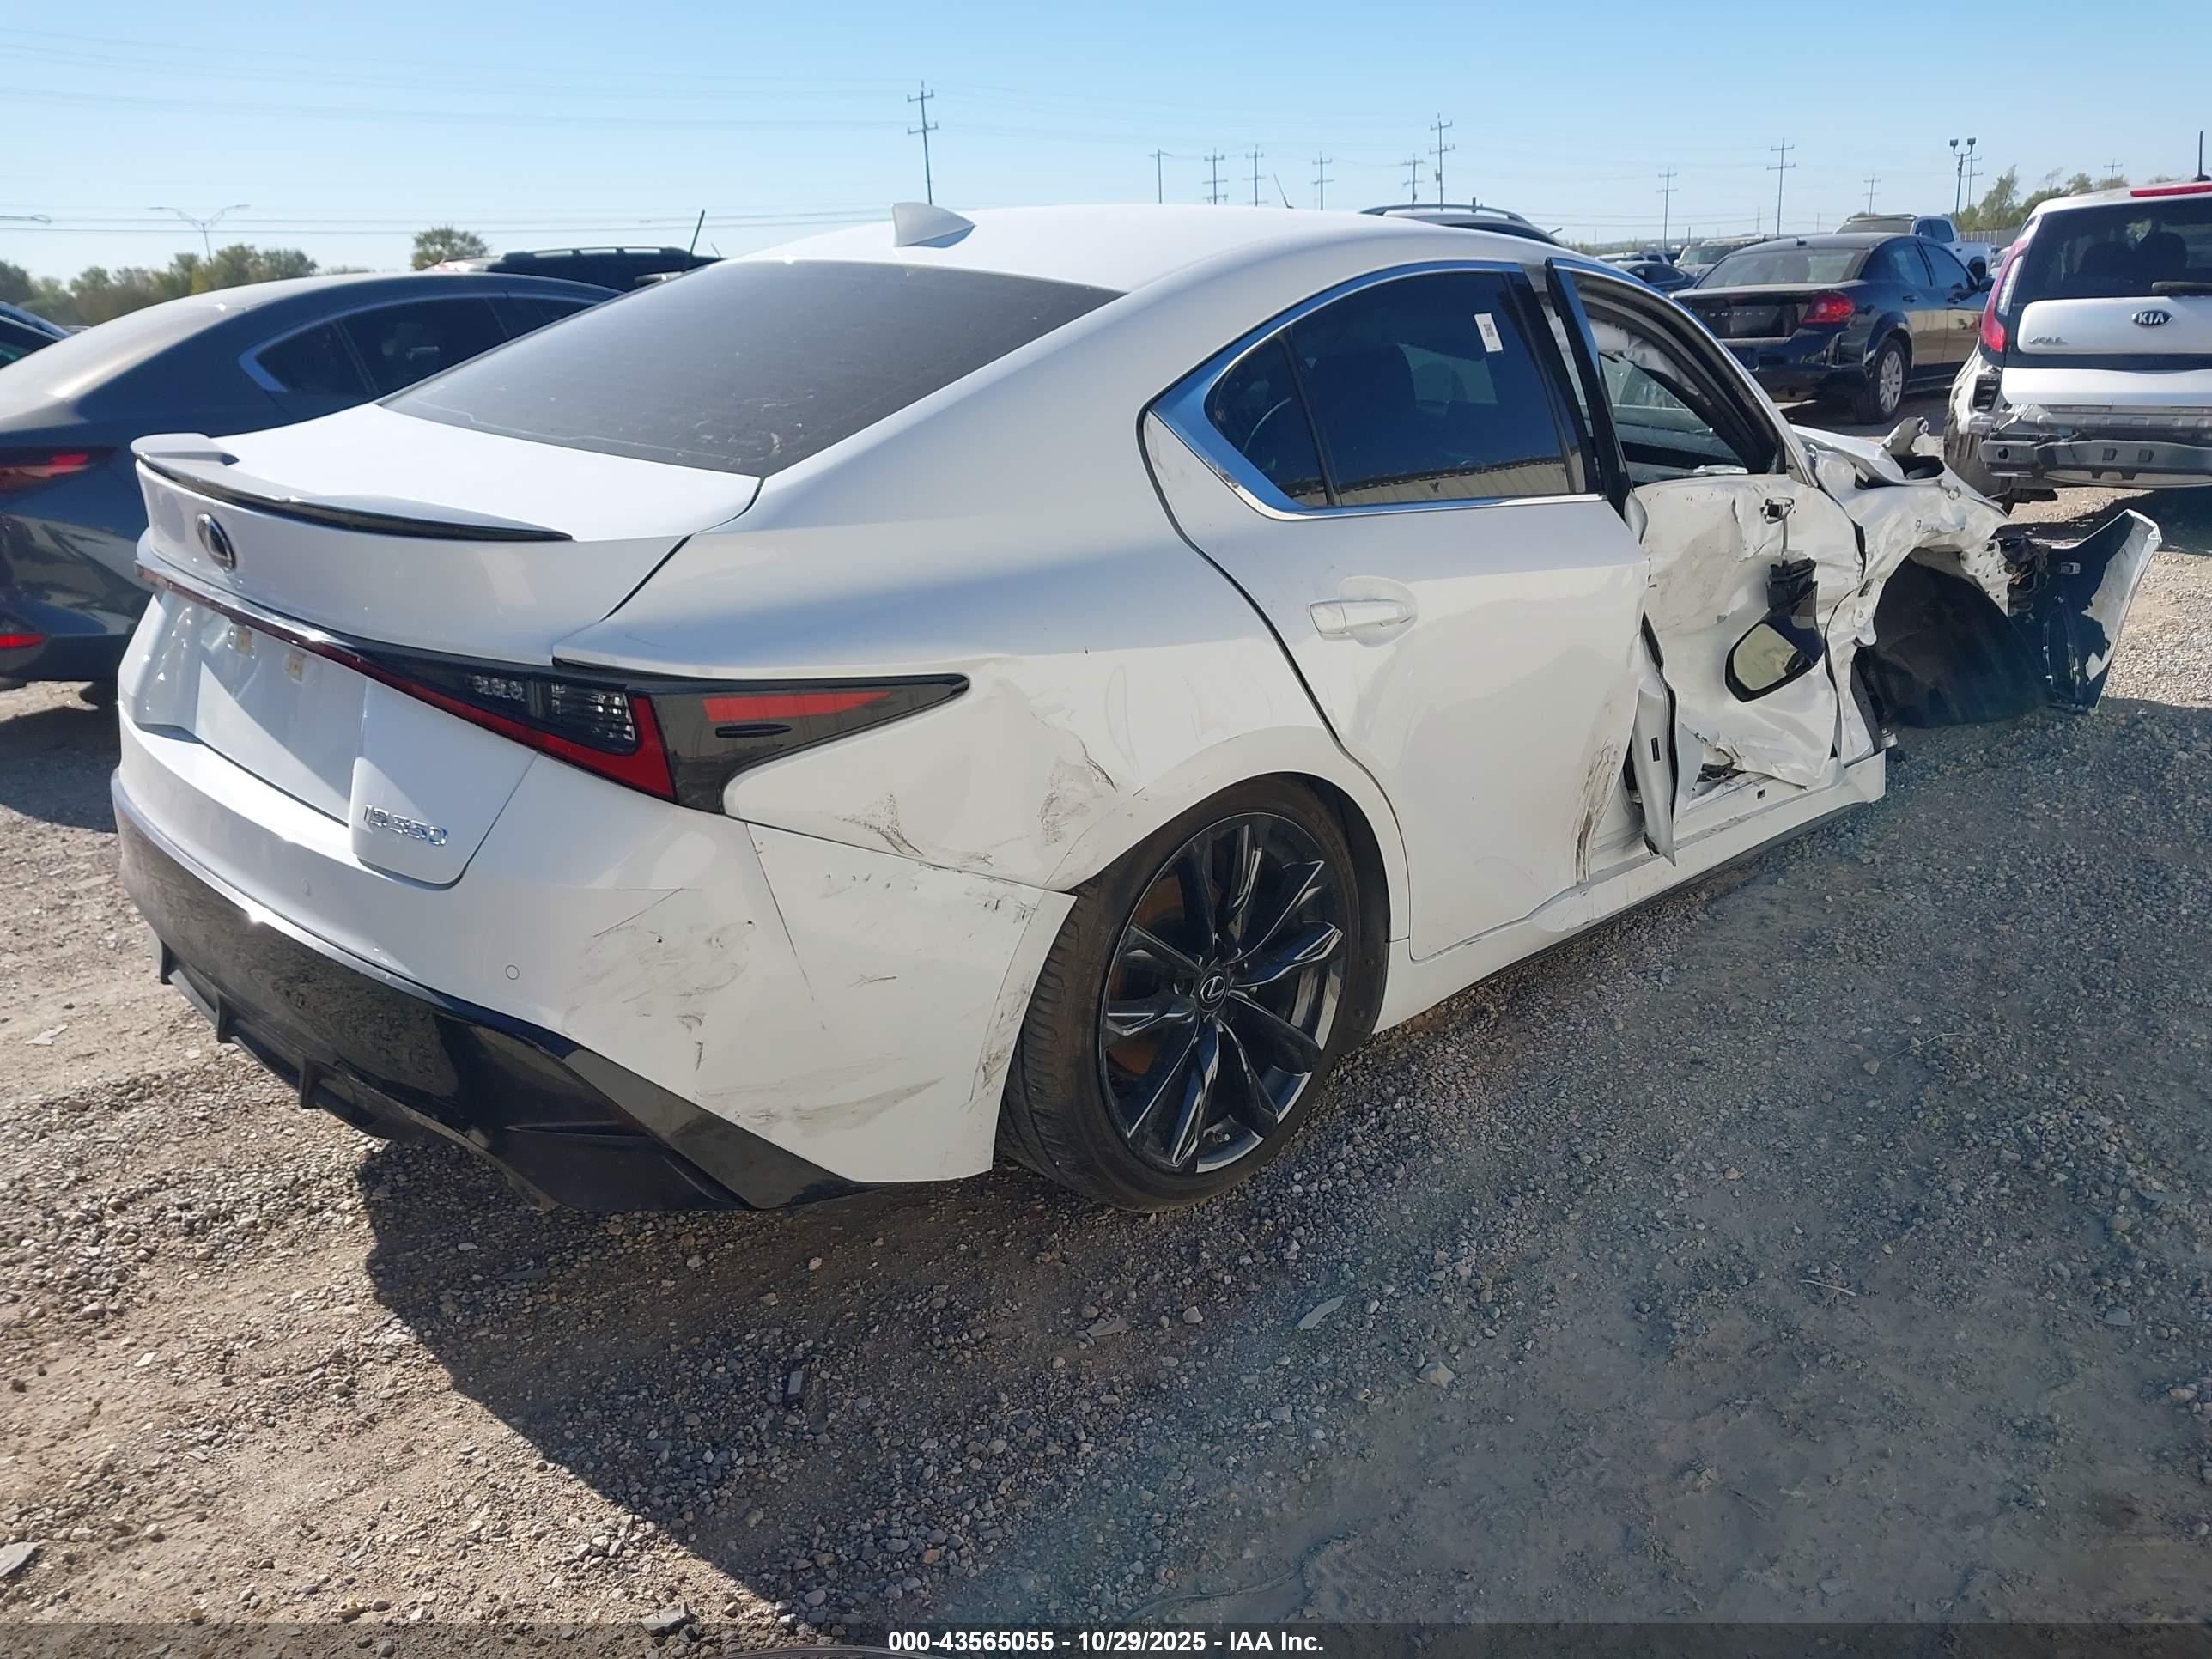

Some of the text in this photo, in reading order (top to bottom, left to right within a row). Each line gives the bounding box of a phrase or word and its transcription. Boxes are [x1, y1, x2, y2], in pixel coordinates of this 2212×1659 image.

[2137, 313, 2165, 325] KIA
[363, 804, 449, 847] IS 350
